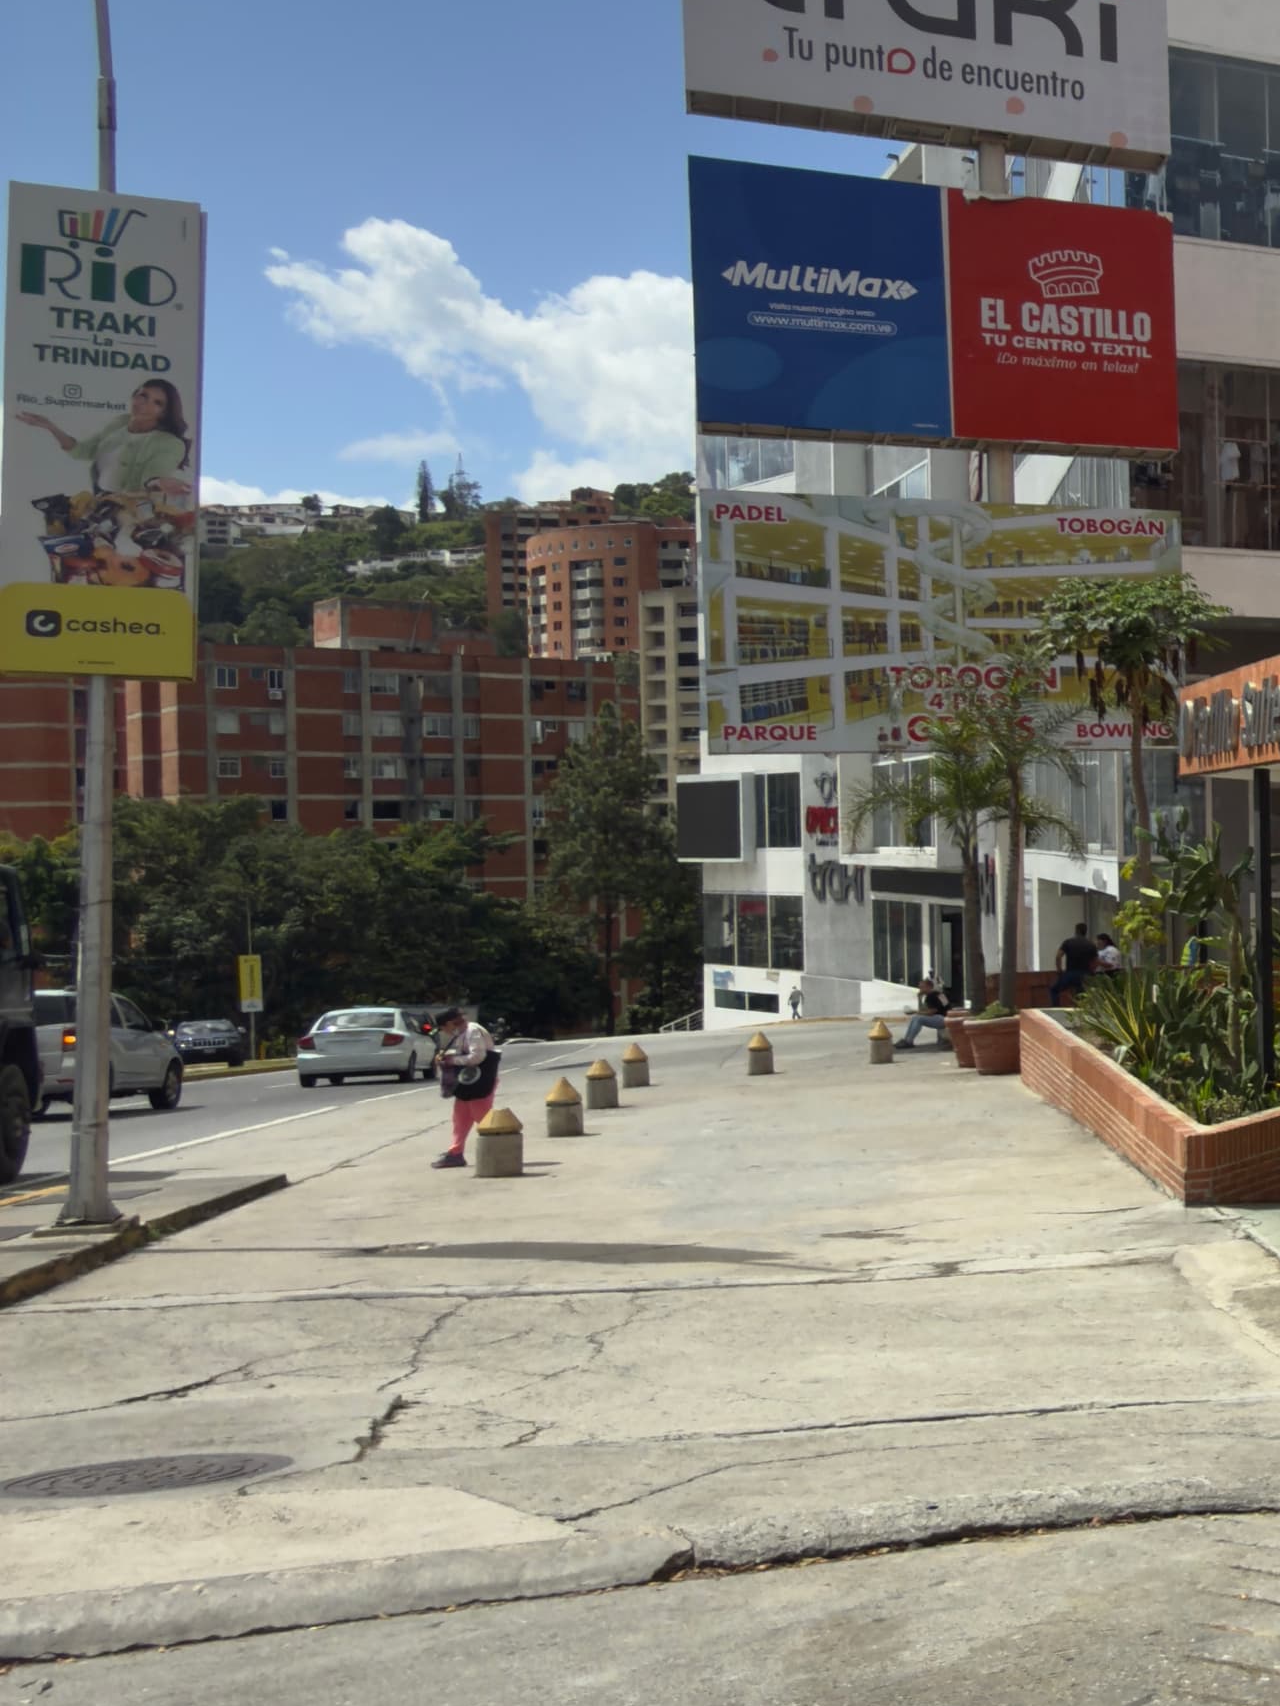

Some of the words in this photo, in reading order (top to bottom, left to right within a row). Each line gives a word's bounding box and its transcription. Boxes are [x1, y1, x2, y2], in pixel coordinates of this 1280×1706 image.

[783, 26, 814, 62] Tu
[825, 36, 916, 75] punto
[922, 45, 953, 82] de
[961, 61, 1085, 101] encuentro
[732, 260, 904, 300] MultiMax
[49, 306, 157, 337] TRAKI
[753, 314, 892, 333] www.multimax.com.ve
[980, 297, 1012, 331] EL
[1021, 301, 1152, 342] CASTILLO
[93, 334, 114, 346] La
[981, 333, 1007, 346] TU
[1012, 336, 1085, 353] CENTRO
[1091, 342, 1152, 358] TEXTIL
[33, 344, 171, 373] TRINIDAD
[715, 504, 787, 523] PADEL
[1056, 517, 1164, 535] TOBOGÁN
[929, 693, 944, 709] 4
[723, 725, 816, 741] PARQUE
